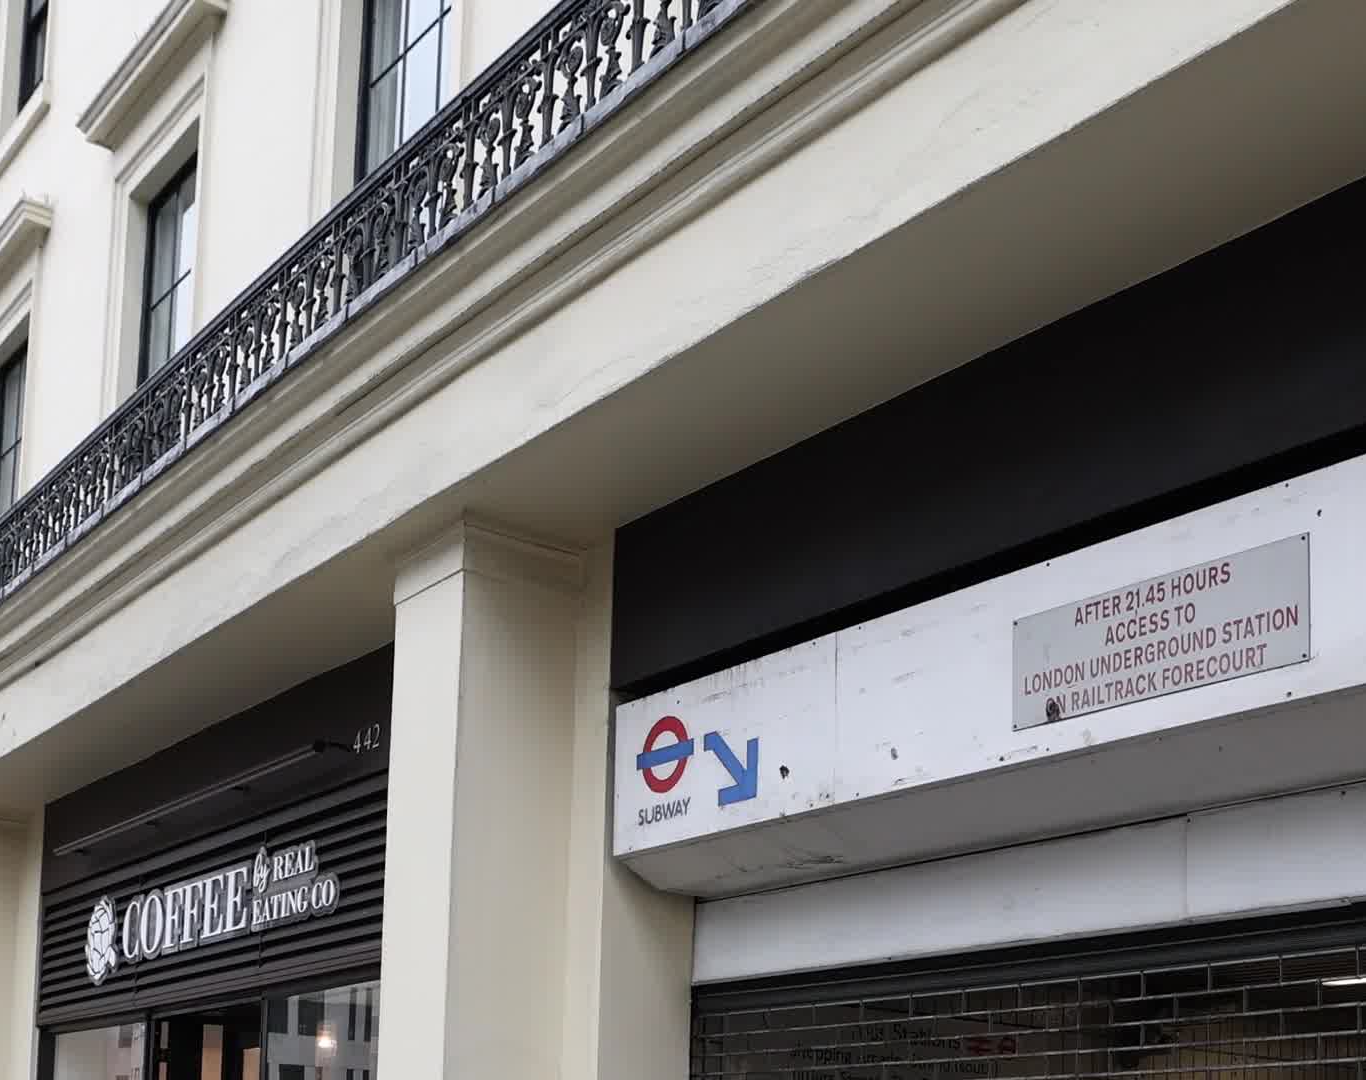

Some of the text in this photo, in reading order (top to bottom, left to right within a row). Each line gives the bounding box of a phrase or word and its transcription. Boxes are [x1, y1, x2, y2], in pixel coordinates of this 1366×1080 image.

[1074, 562, 1231, 627] AFTER 21.45 HOURS
[1024, 604, 1299, 696] LONDON UNDERGROUND STATION
[1105, 602, 1196, 646] ACCESS TO
[1071, 674, 1157, 712] RAILTRACK
[1162, 643, 1268, 690] FORECOURT
[353, 723, 380, 754] 442
[638, 796, 691, 826] SUBWAY
[122, 846, 316, 960] COFFEE by REAL
[252, 879, 336, 926] EATING CO
